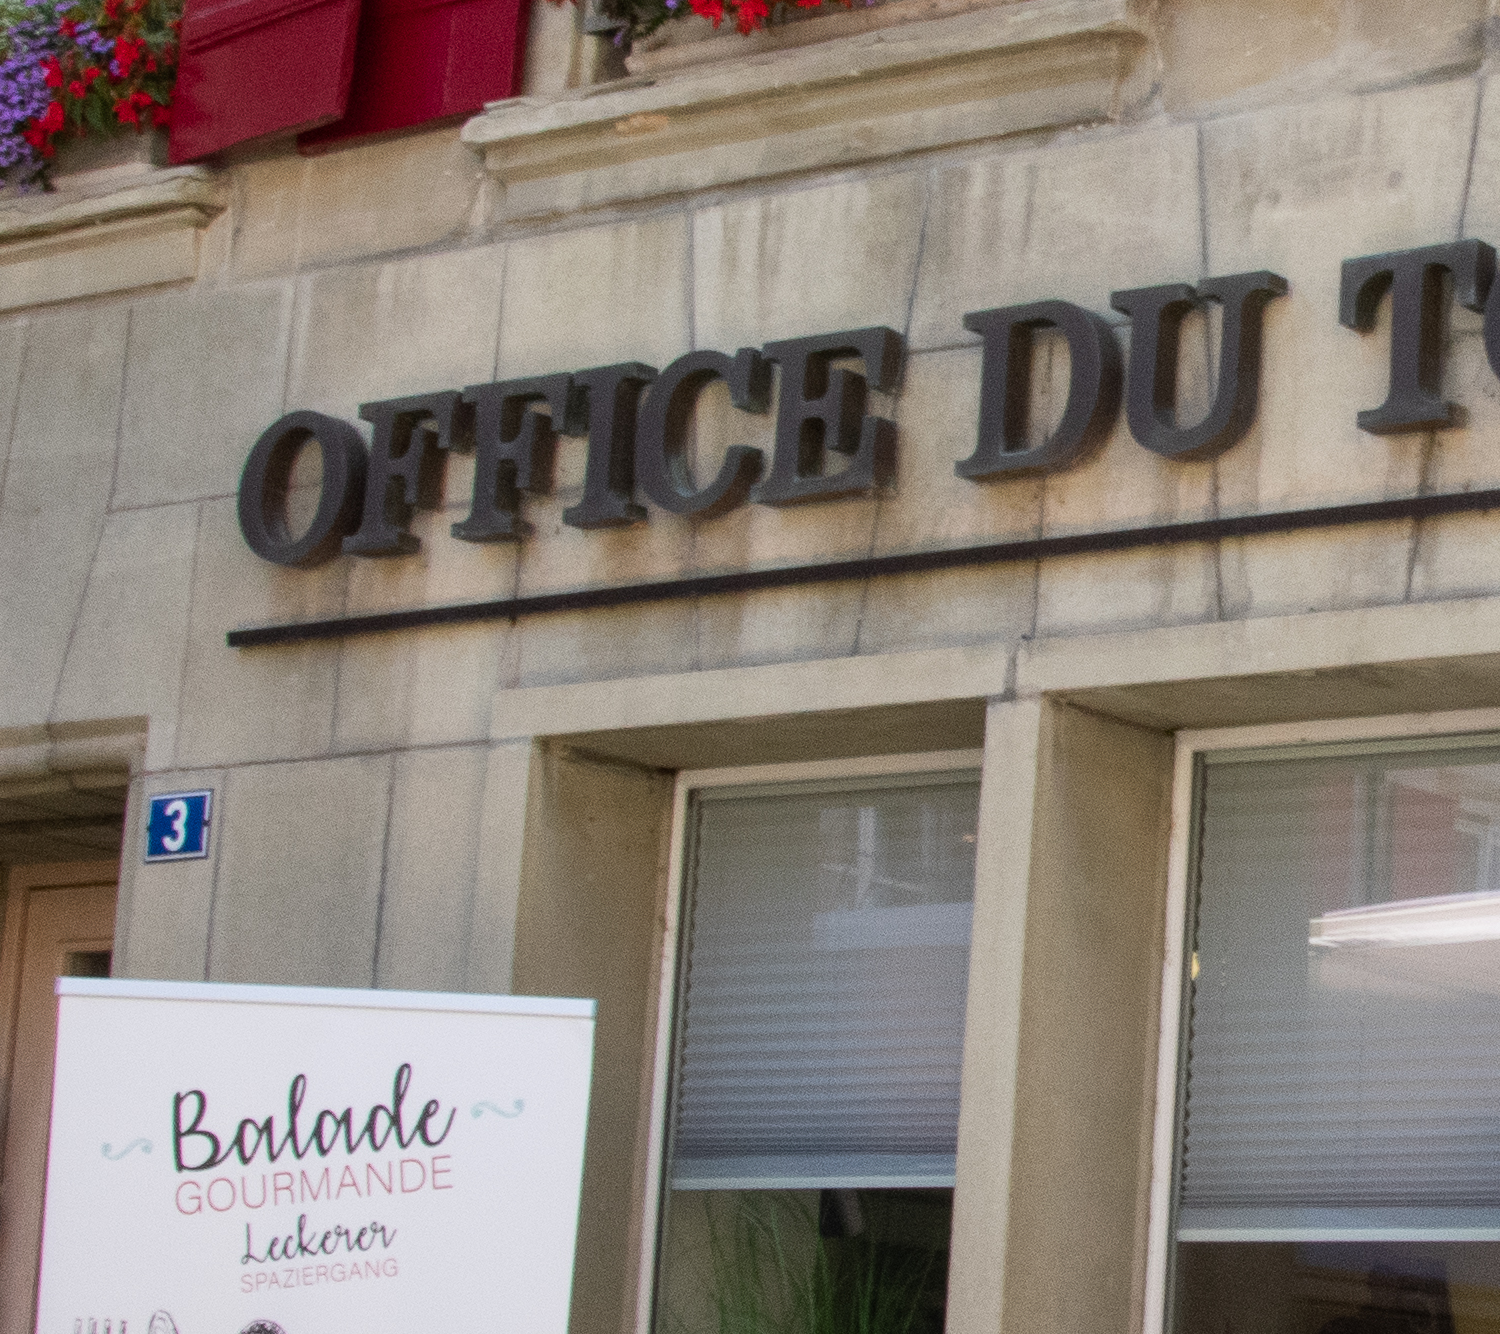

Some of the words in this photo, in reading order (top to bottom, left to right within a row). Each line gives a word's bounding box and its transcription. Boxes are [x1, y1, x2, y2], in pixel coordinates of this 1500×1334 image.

[236, 326, 901, 567] OFFICE
[955, 271, 1289, 480] DU
[161, 799, 189, 852] 3
[172, 1063, 456, 1173] Balade
[175, 1155, 454, 1215] GOURMANDE
[240, 1213, 397, 1265] Leckerer
[240, 1258, 400, 1294] SPAZIERGANG
